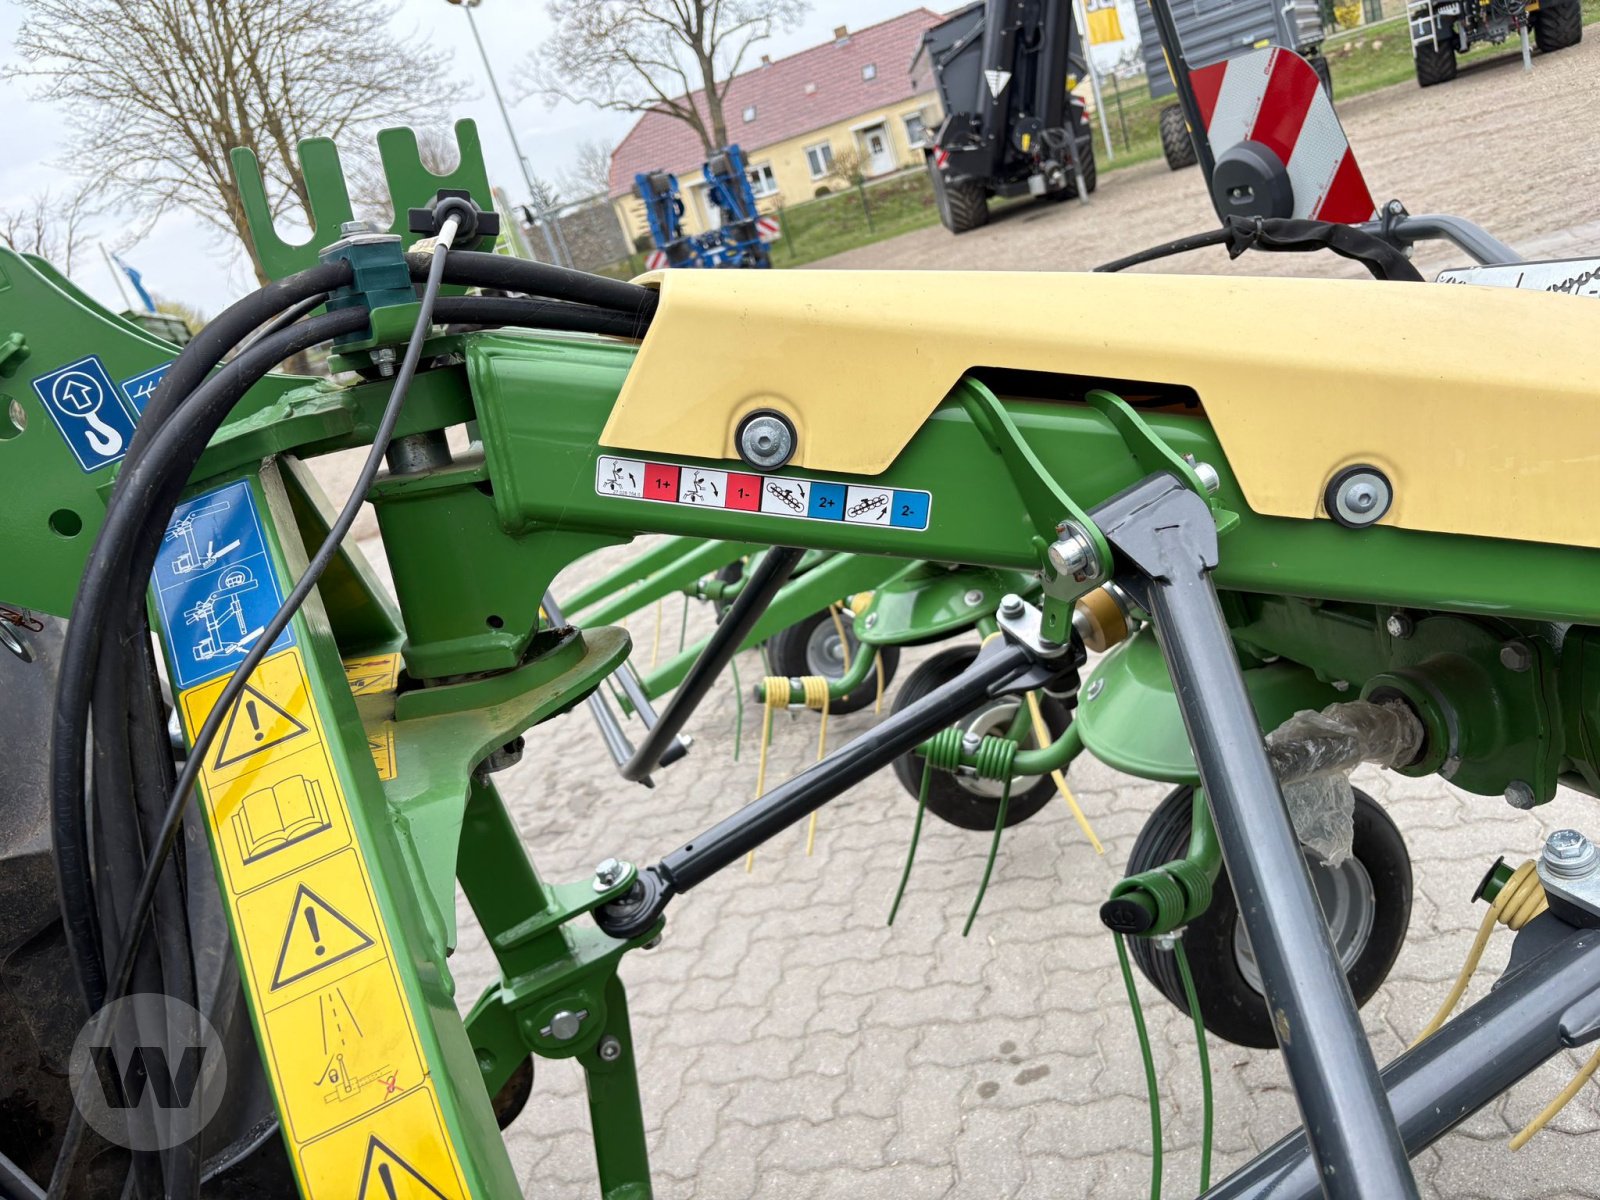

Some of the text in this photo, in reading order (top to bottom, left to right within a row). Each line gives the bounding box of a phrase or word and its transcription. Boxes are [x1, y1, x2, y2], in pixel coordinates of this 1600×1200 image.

[655, 478, 671, 489] 1+
[738, 488, 750, 499] 1-
[819, 497, 835, 508] 2+
[901, 505, 915, 516] 2-
